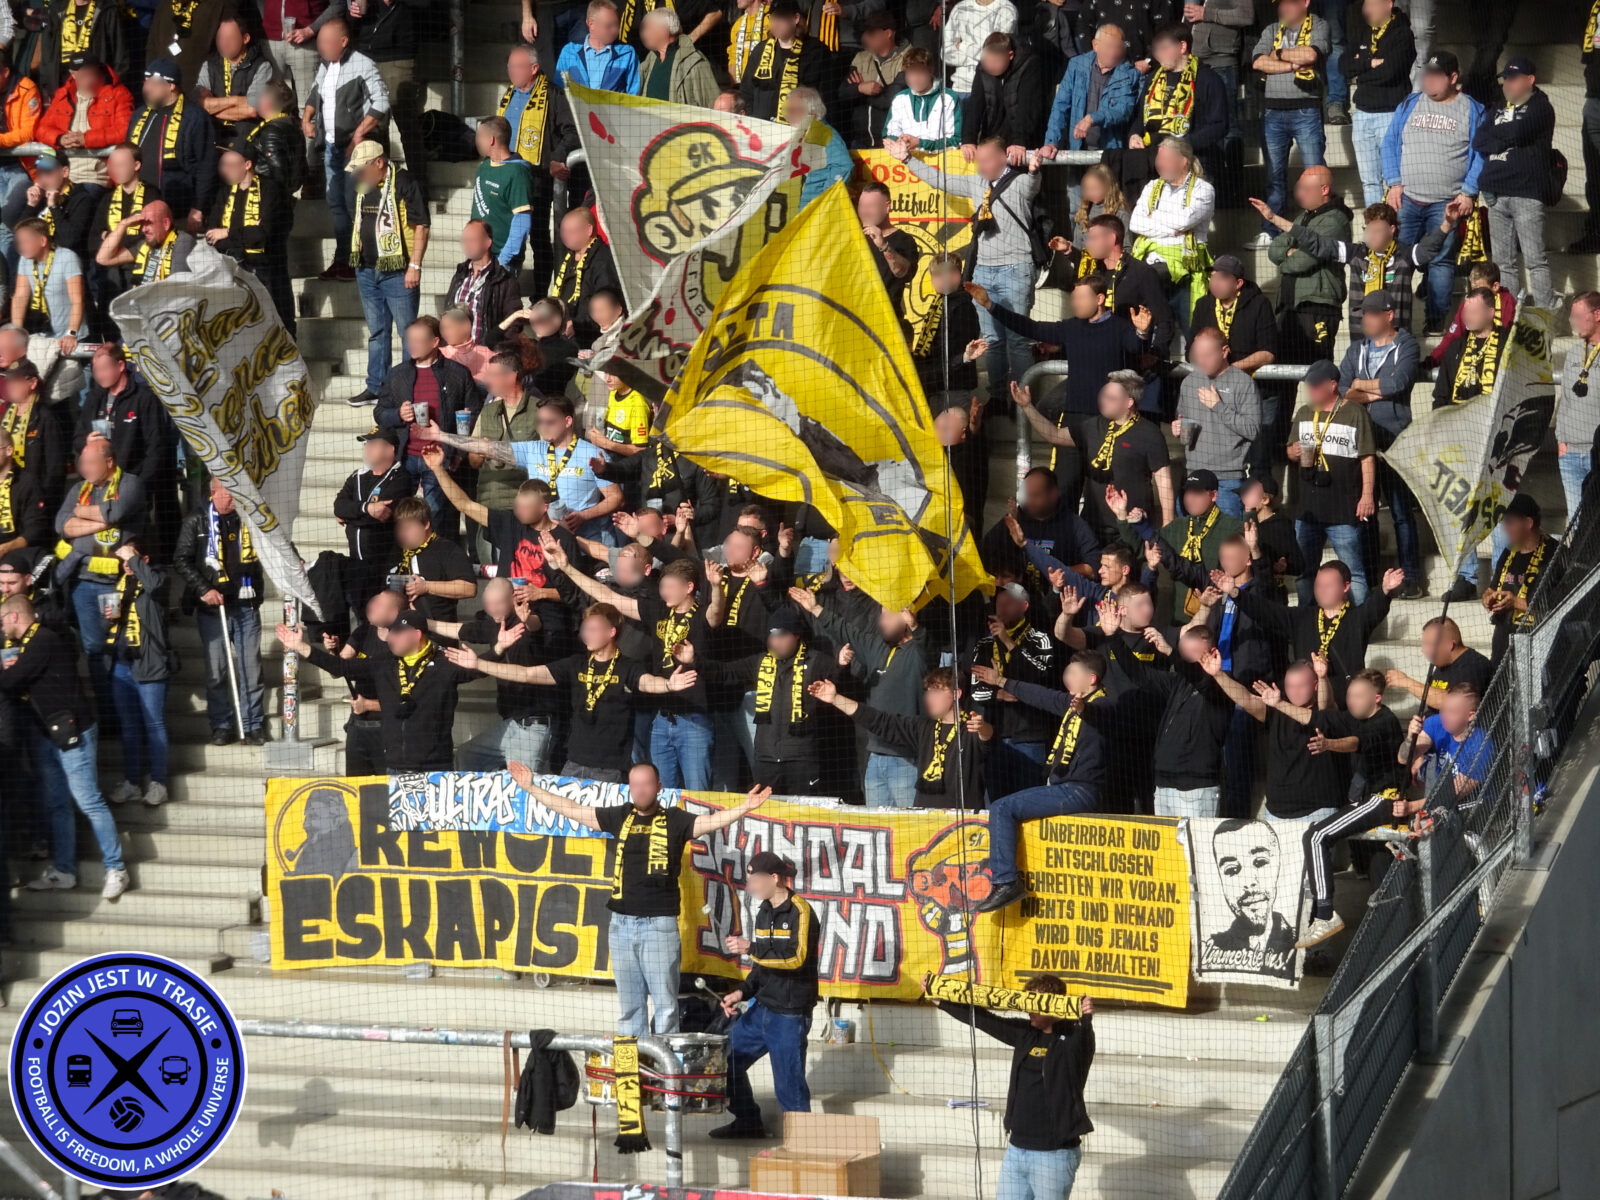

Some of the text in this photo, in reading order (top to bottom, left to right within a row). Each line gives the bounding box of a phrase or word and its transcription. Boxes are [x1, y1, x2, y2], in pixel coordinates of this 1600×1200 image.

[687, 142, 716, 168] SK
[428, 772, 517, 826] ULTRAS
[968, 831, 984, 848] SK
[1039, 818, 1161, 851] UNBEIRRBAR UND
[685, 799, 909, 902] SKANDAL
[1045, 847, 1154, 877] ENTSCHLOSSEN
[1020, 870, 1181, 905] SCHREITEN WIR VORAN.
[1020, 897, 1175, 929] NICHTS UND NIEMAND
[1035, 922, 1159, 953] WIRD UNS JEMALS
[1031, 948, 1161, 979] DAVON ABHALTEN!
